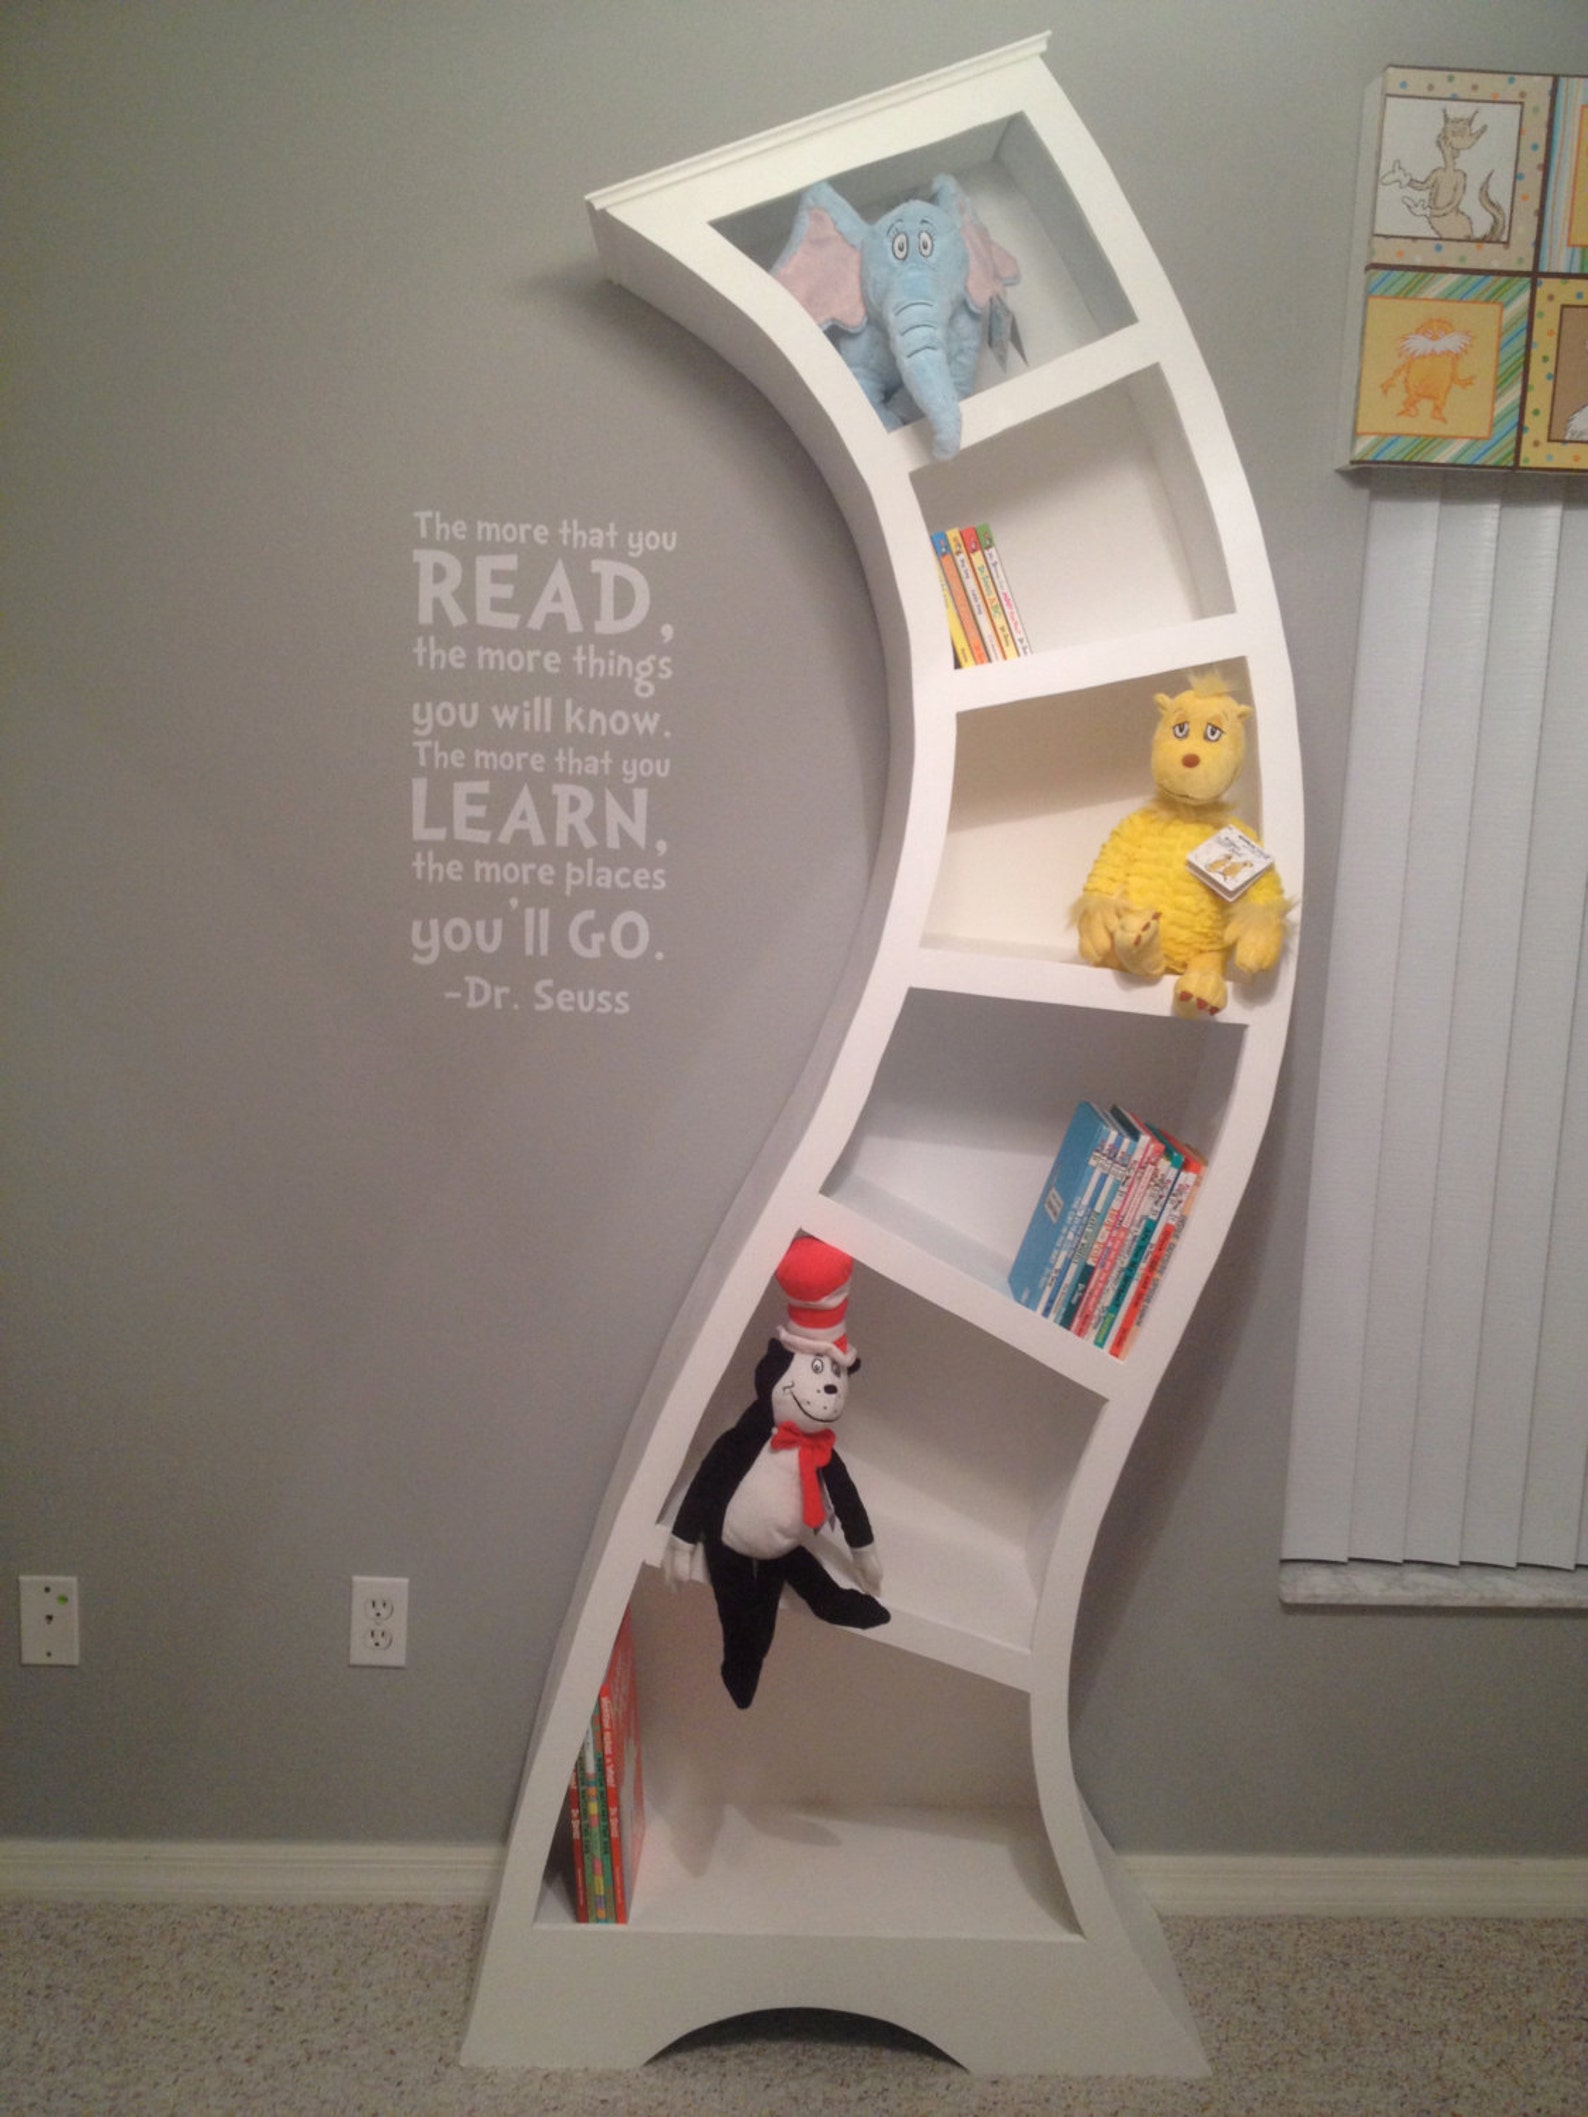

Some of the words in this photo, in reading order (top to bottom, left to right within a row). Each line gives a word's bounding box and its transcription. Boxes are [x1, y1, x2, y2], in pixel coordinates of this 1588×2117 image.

[413, 511, 467, 541] The
[476, 519, 549, 544] more
[559, 519, 618, 548] that
[627, 530, 677, 557] you
[412, 548, 674, 643] READ,
[413, 636, 467, 670] the
[477, 645, 562, 673] more
[573, 644, 673, 698] things
[412, 700, 479, 736] you
[491, 697, 551, 732] will
[565, 699, 671, 738] know.
[412, 741, 465, 769] The
[474, 749, 546, 773] more
[555, 748, 613, 776] that
[622, 757, 671, 783] you
[411, 777, 668, 857] LEARN,
[412, 850, 463, 883] the
[474, 858, 555, 885] more
[565, 857, 666, 897] places
[411, 897, 550, 965] you'll
[568, 909, 664, 960] GO.
[534, 979, 630, 1014] Seuss
